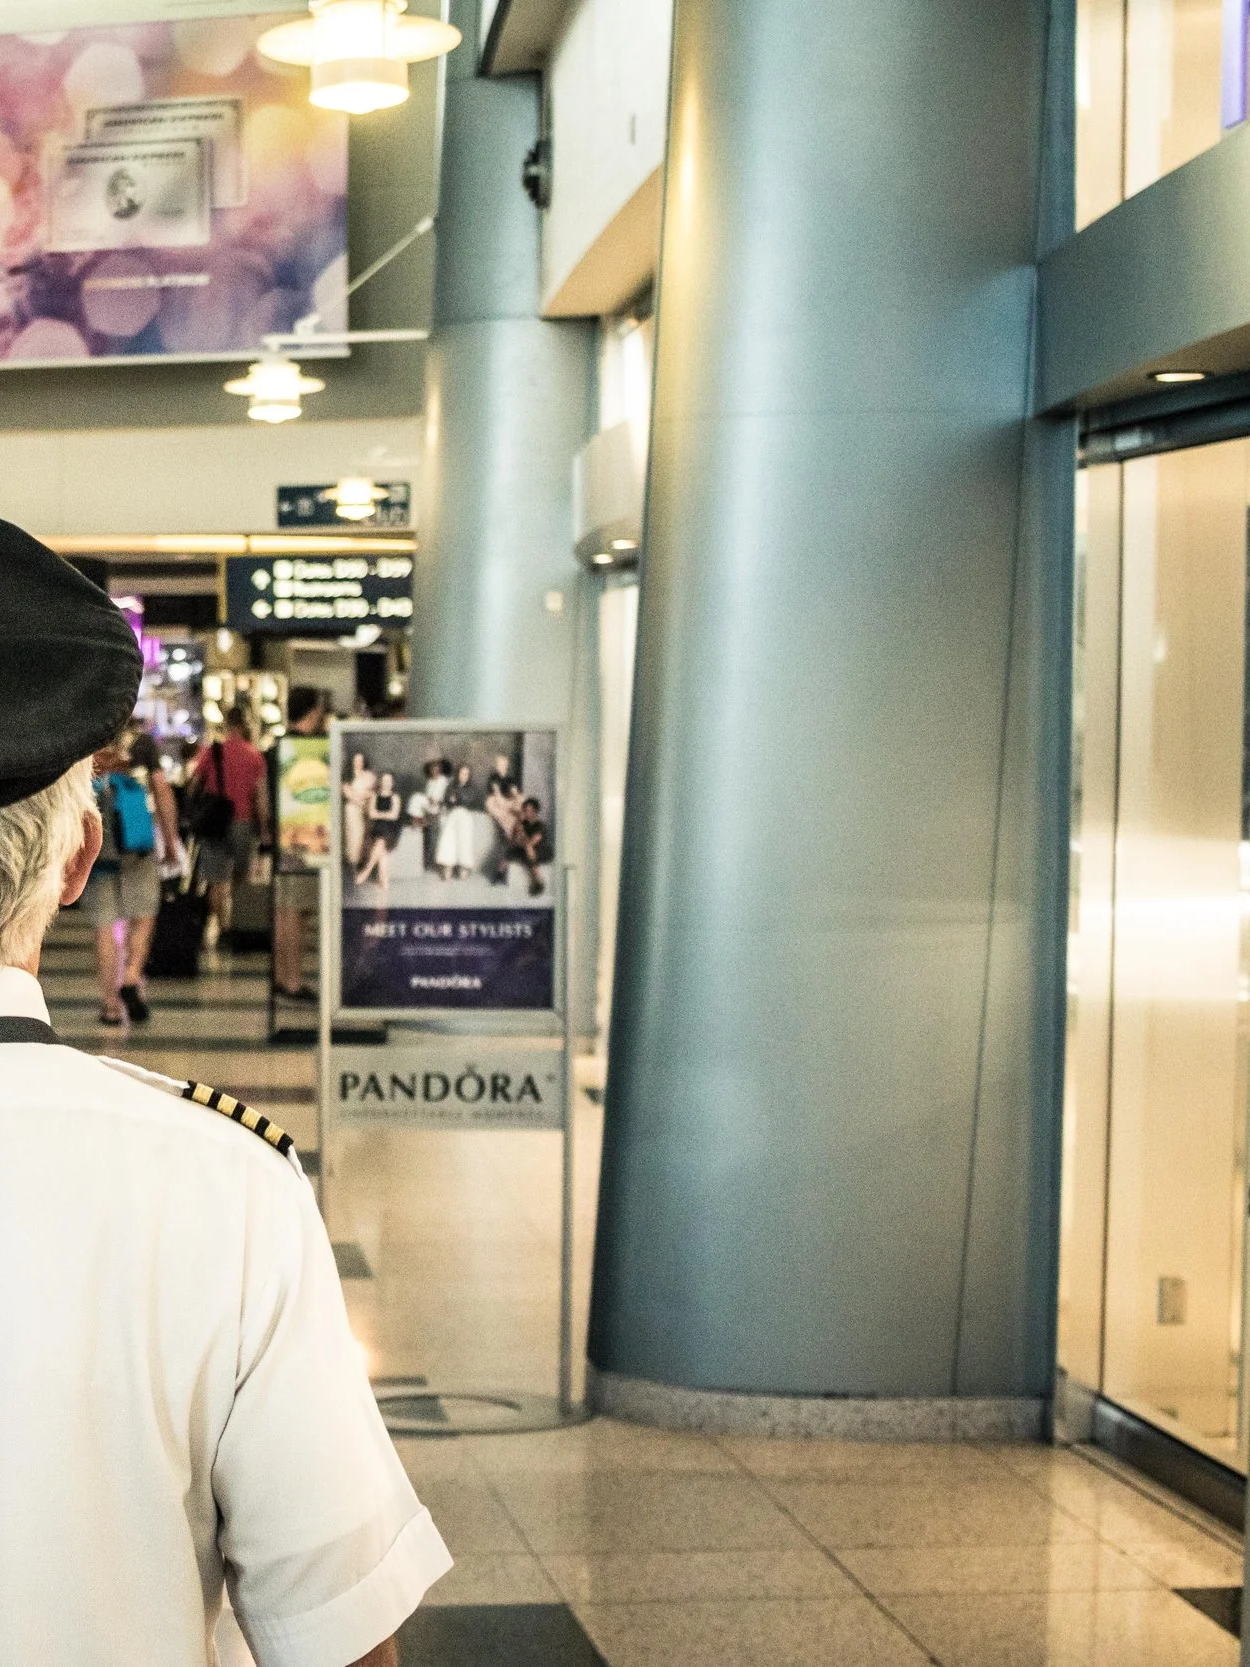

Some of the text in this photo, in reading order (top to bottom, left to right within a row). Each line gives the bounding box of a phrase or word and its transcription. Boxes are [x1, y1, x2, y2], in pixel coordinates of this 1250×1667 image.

[364, 922, 533, 939] MEET OUR STYLISTS
